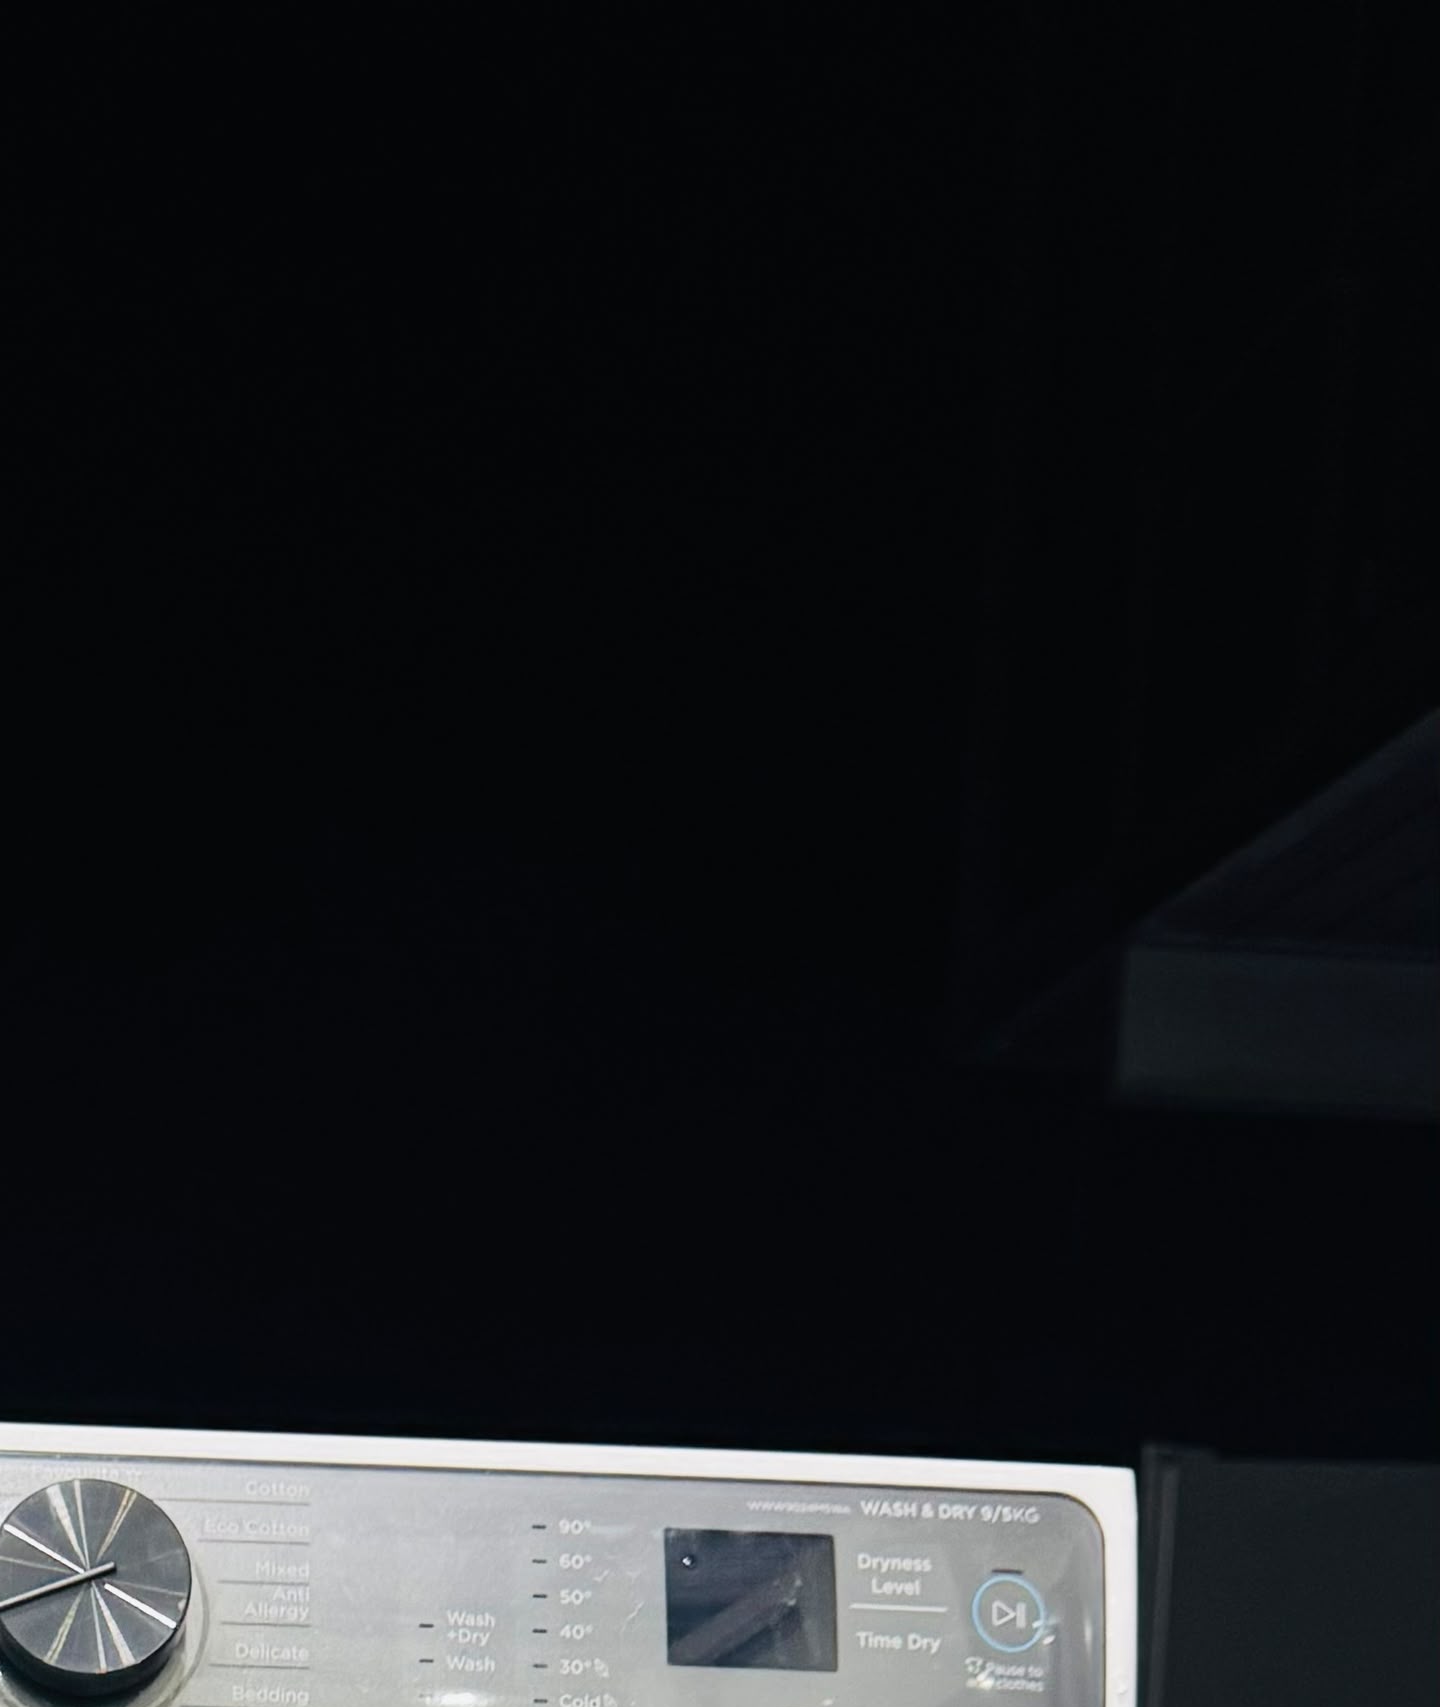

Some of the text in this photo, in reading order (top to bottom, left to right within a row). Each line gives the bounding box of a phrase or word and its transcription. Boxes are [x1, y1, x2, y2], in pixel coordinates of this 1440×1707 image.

[245, 1480, 310, 1498] Cotton
[860, 1501, 920, 1518] WASH
[922, 1503, 934, 1519] &
[938, 1504, 977, 1521] DRY
[980, 1505, 1041, 1524] 9/5KG
[203, 1519, 310, 1537] Eco Cotton
[255, 1560, 310, 1578] Mixed
[857, 1553, 933, 1573] Dryness
[273, 1586, 310, 1602] Anti
[871, 1578, 922, 1596] Level
[244, 1601, 310, 1621] Allergy
[446, 1610, 496, 1628] Wash
[447, 1628, 492, 1646] +Dry
[856, 1632, 942, 1654] Time Dry
[235, 1642, 310, 1660] Delicate
[446, 1655, 496, 1672] Wash
[232, 1685, 310, 1706] Bedding
